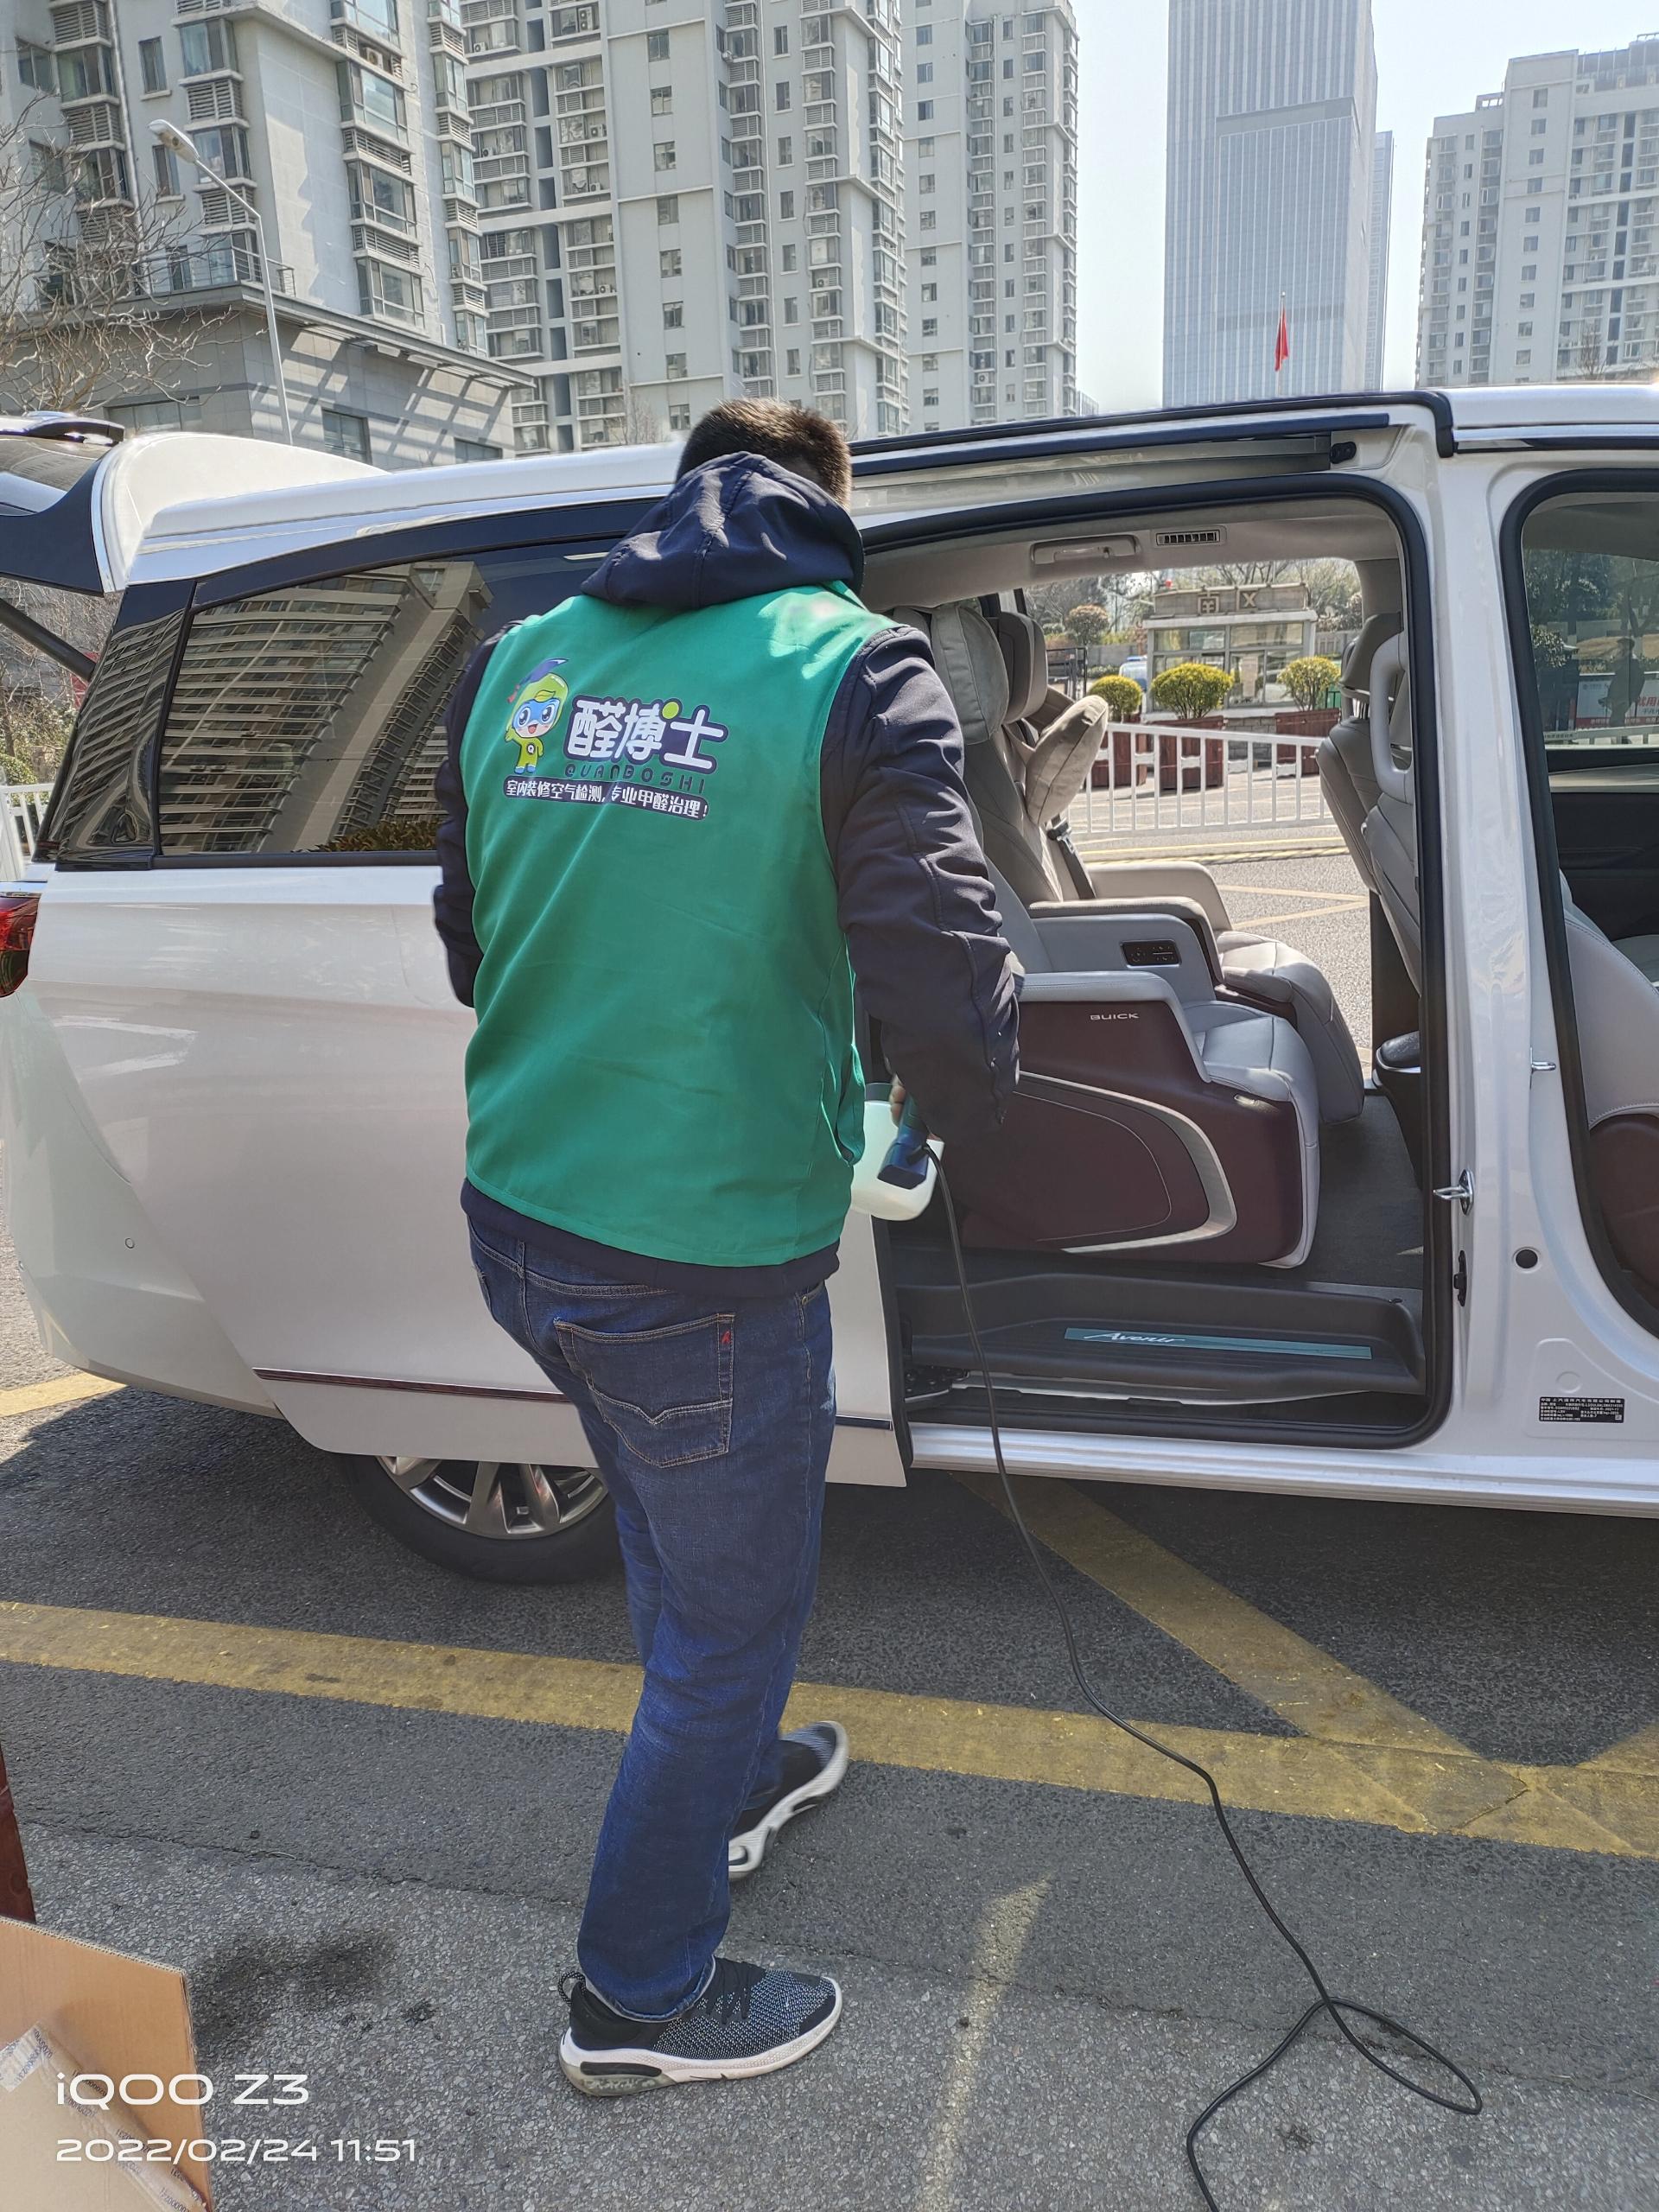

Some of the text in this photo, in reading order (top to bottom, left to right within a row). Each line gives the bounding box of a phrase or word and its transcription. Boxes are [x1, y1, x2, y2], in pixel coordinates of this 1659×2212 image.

[566, 698, 725, 771] 醛博士
[564, 763, 705, 793] QUANBOSHI
[1084, 1332, 1185, 1343] Avenir
